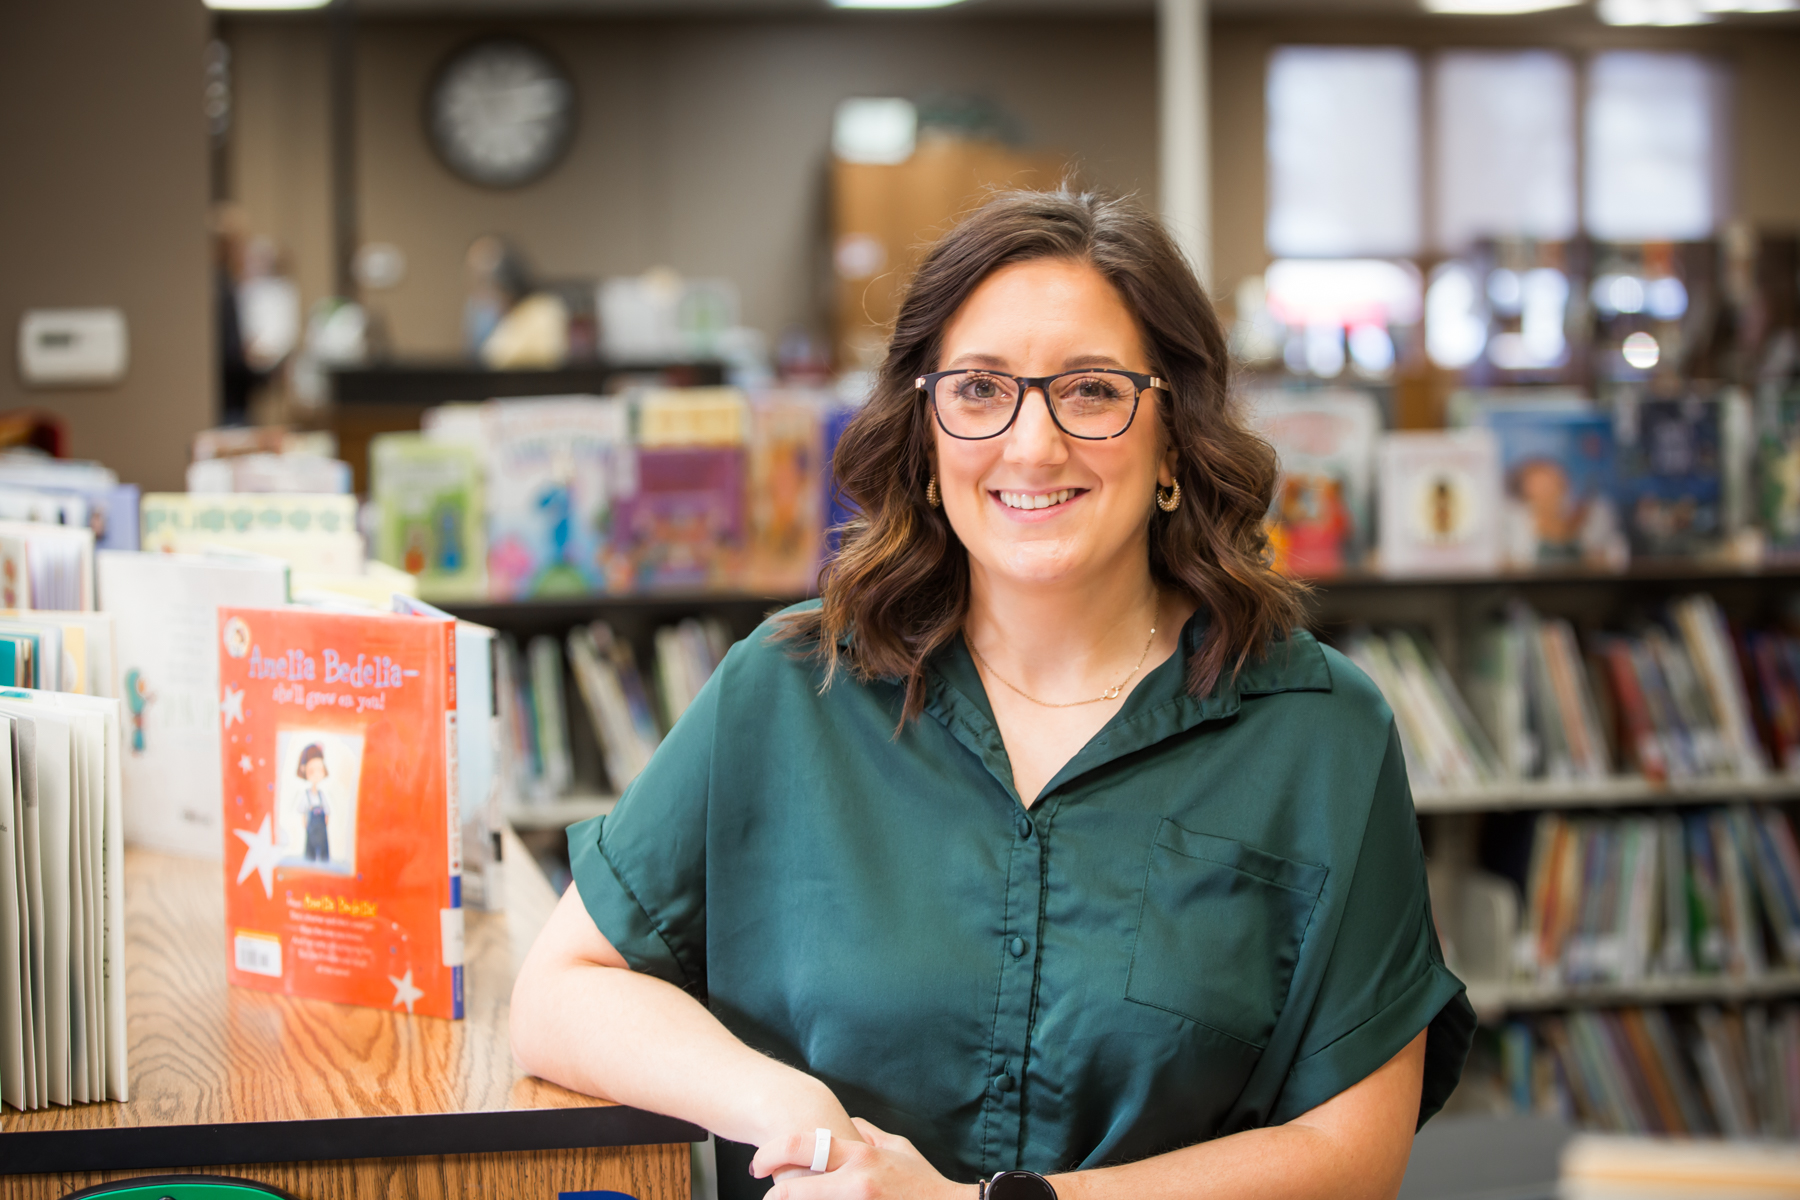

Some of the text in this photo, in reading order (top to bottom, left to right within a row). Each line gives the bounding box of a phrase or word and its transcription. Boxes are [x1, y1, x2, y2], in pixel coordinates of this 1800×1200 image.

[248, 644, 316, 680] Amelia
[305, 691, 337, 711] grow
[338, 694, 355, 708] on
[356, 691, 386, 713] you!
